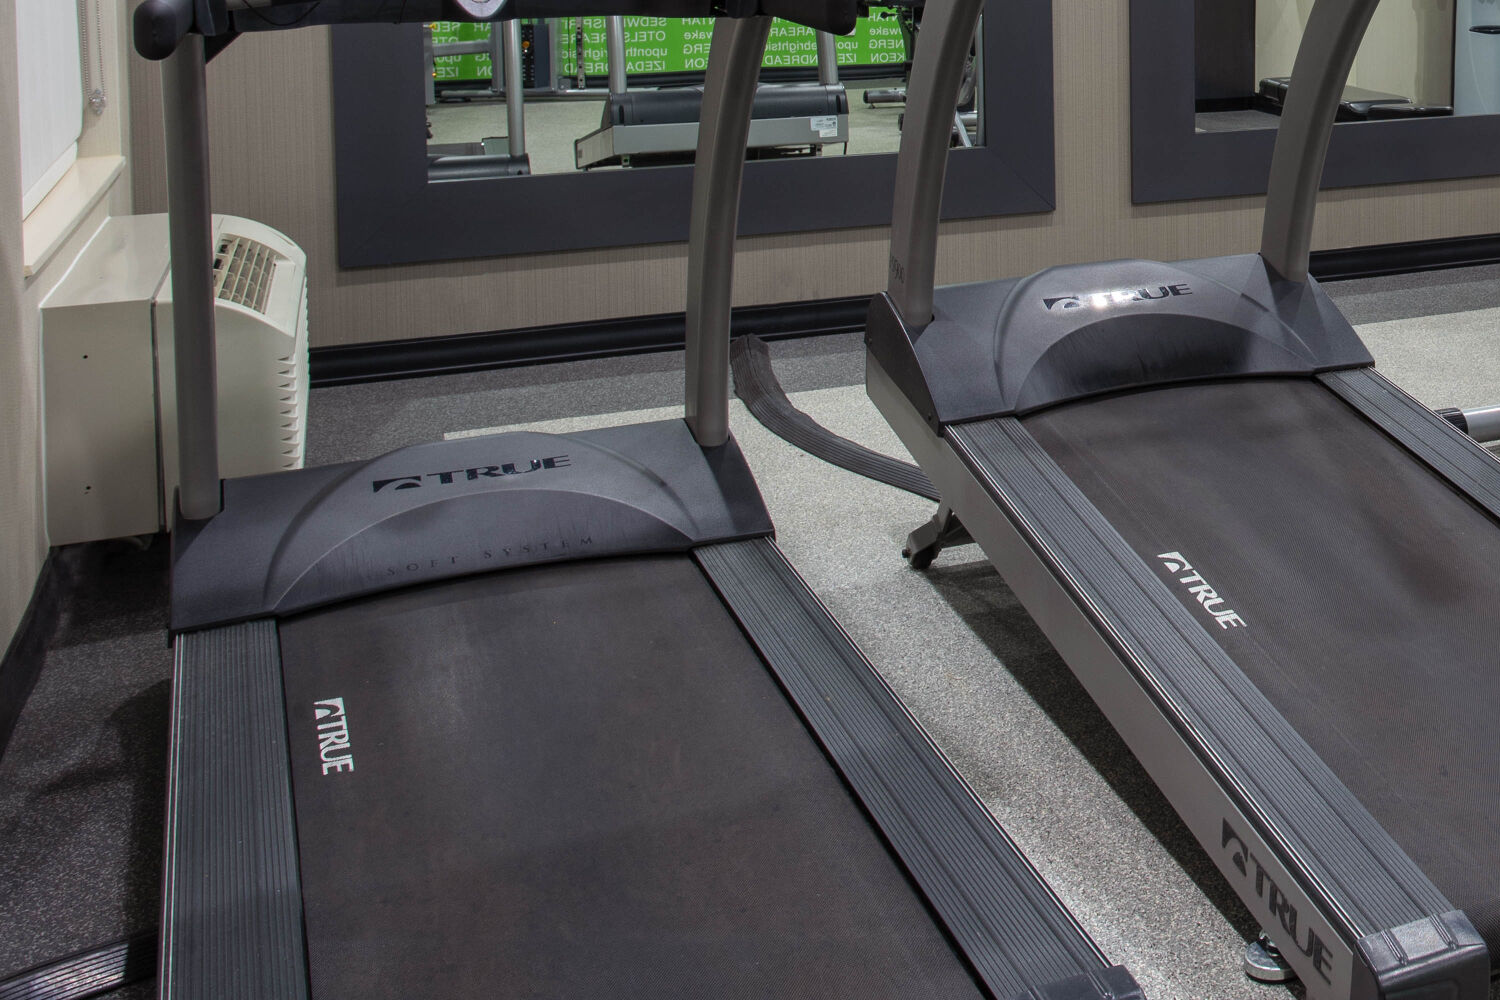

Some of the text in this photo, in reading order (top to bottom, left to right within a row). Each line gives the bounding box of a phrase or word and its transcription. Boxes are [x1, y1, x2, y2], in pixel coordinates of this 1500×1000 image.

[427, 454, 572, 484] TRUE
[1179, 569, 1248, 630] TRUE
[316, 715, 355, 776] TRUE
[1250, 852, 1334, 987] TRUE
